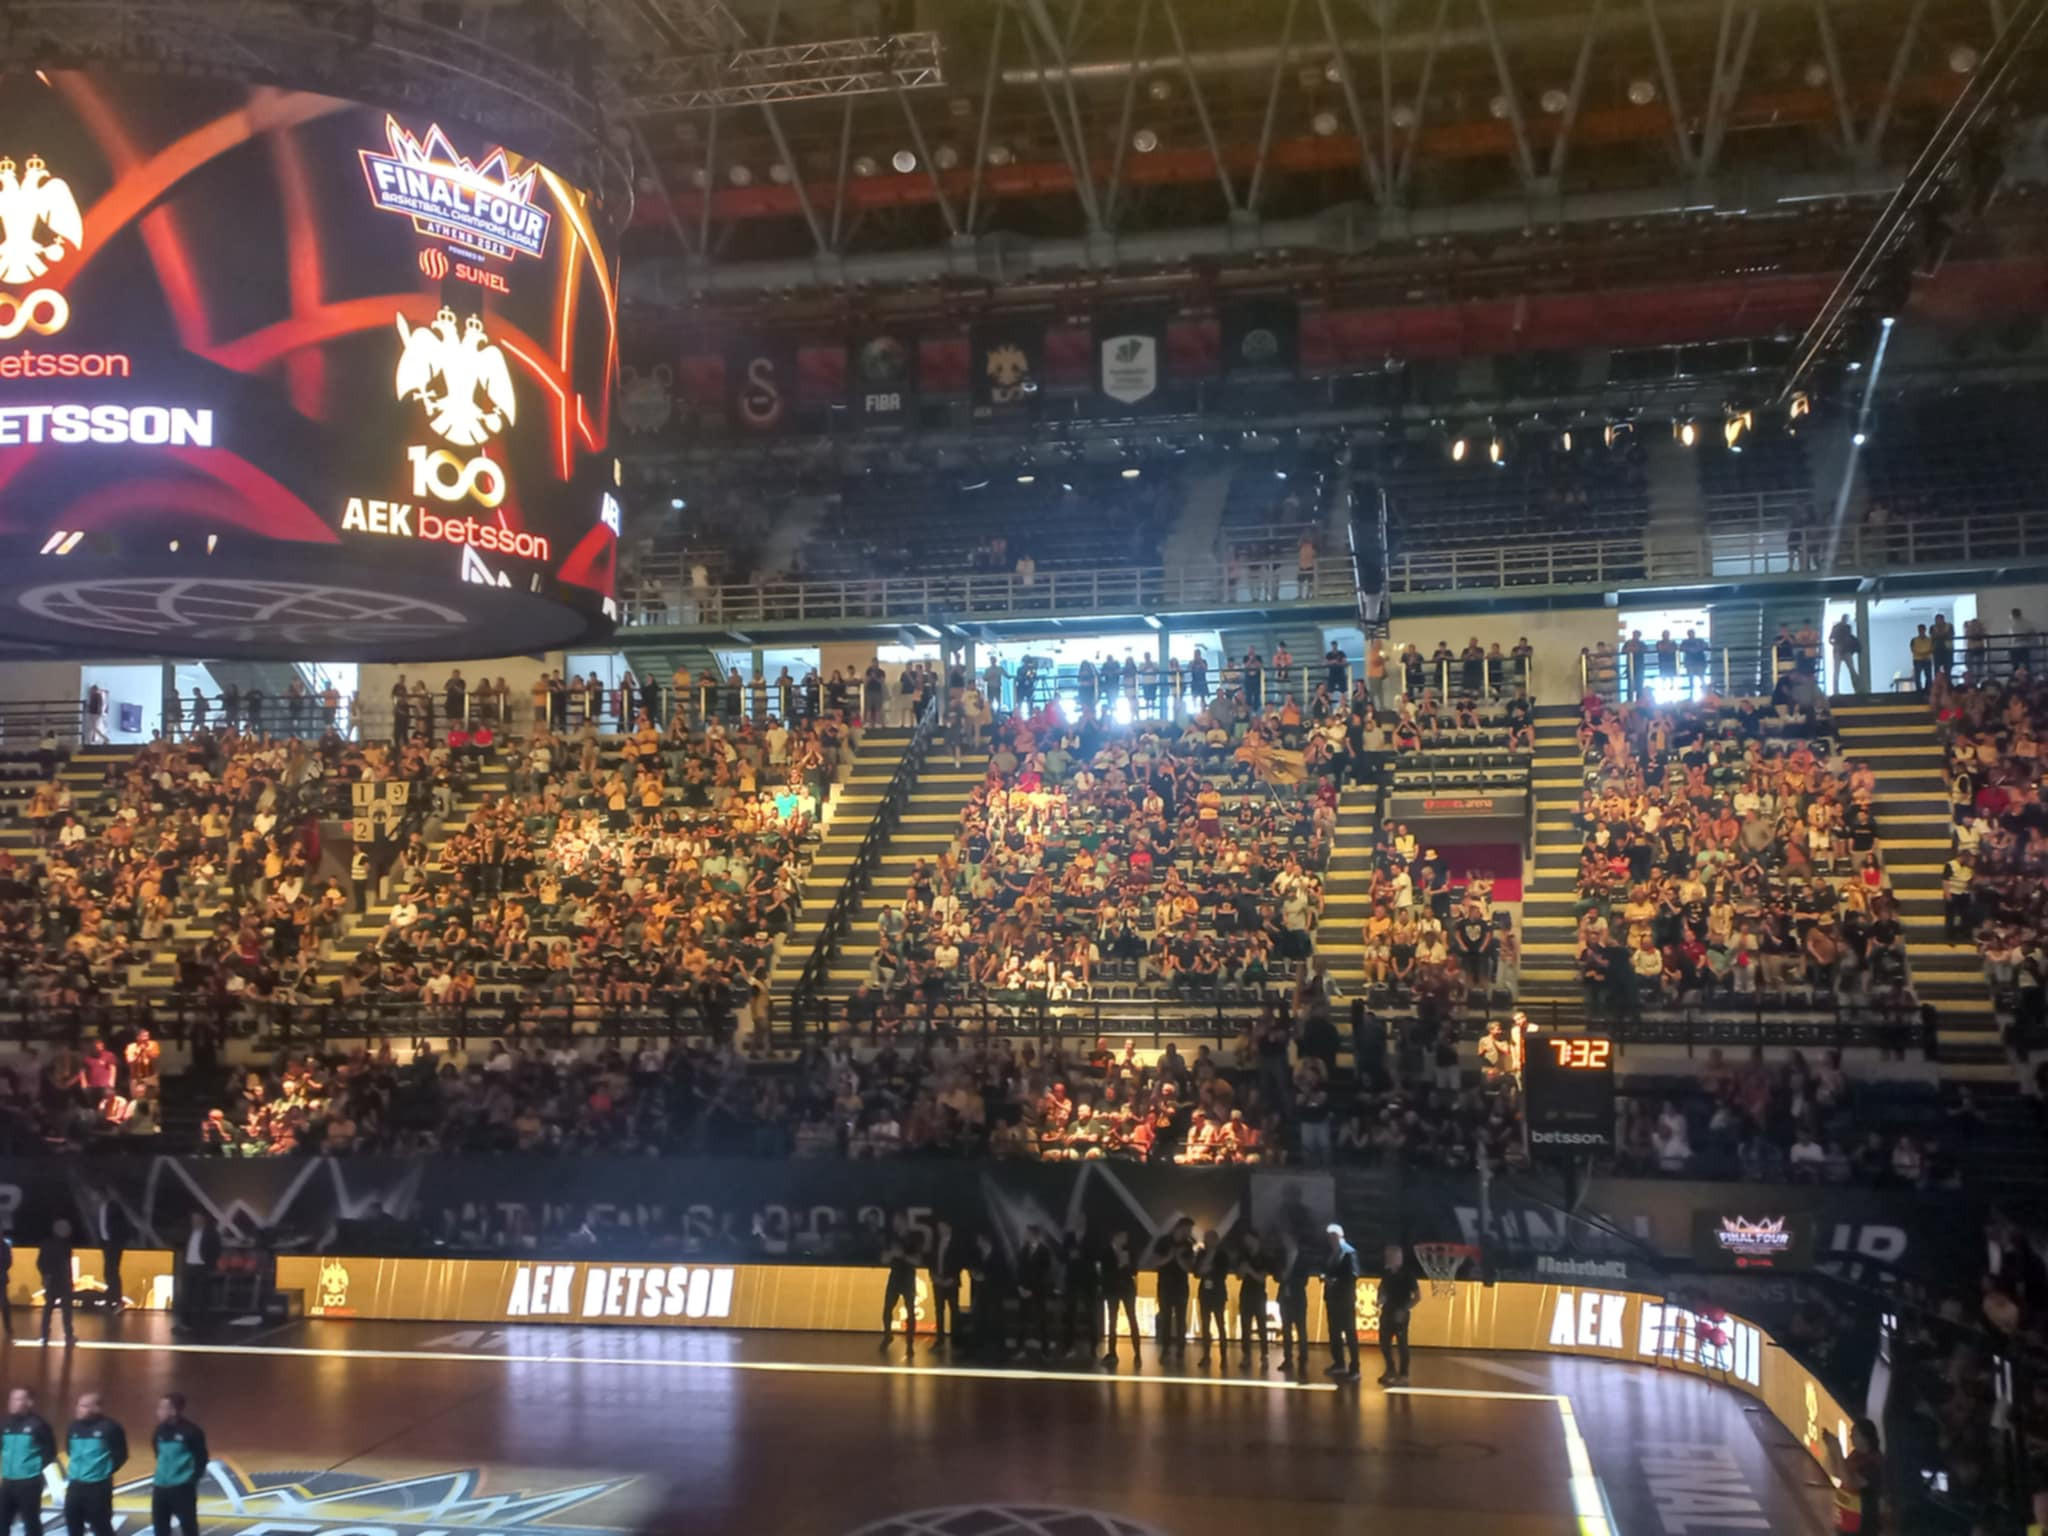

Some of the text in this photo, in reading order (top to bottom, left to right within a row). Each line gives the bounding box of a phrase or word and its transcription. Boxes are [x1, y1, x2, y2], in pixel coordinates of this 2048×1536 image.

[373, 162, 544, 238] FINAL FOUR
[382, 191, 540, 250] BASKETBALL CHAMPIONS LEAGUE
[427, 221, 474, 246] ATHENS
[455, 263, 510, 294] SUNEL
[865, 392, 901, 412] FIBA
[407, 445, 506, 508] 100
[341, 497, 550, 561] AEK betsson
[1549, 1039, 1610, 1068] 7:32
[1719, 1231, 1789, 1244] FINAL FOUR
[323, 1294, 346, 1307] 100
[507, 1265, 735, 1318] AEK BETSSON
[1550, 1292, 1627, 1349] AEK
